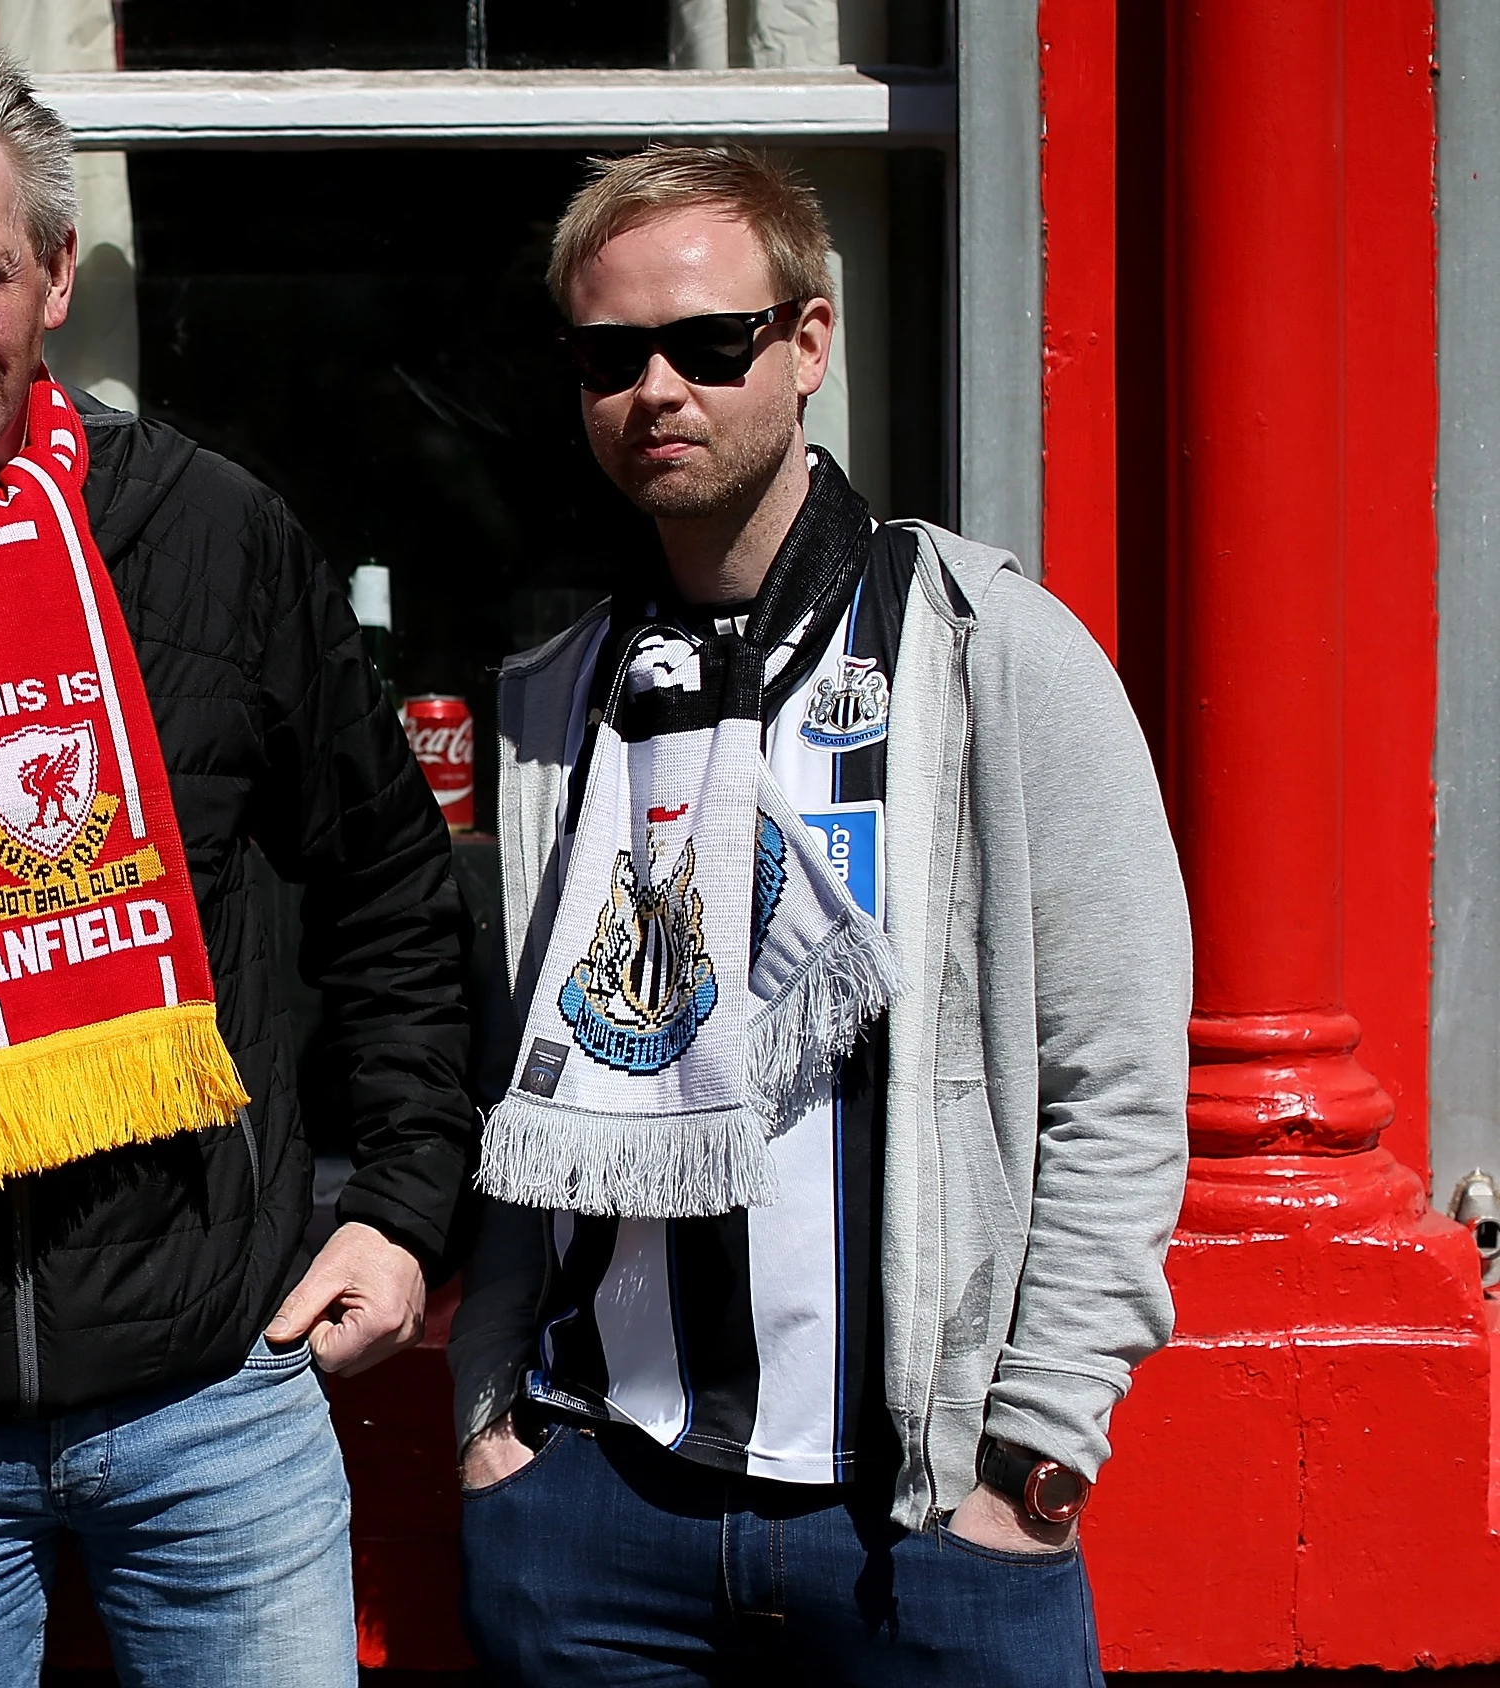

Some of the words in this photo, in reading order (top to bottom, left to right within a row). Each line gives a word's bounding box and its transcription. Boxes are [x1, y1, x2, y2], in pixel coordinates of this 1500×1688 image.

[57, 671, 101, 706] IS
[810, 733, 851, 746] NEWCASTLE
[851, 729, 880, 743] UNITED
[831, 823, 851, 882] .com
[89, 862, 140, 897] CLUB
